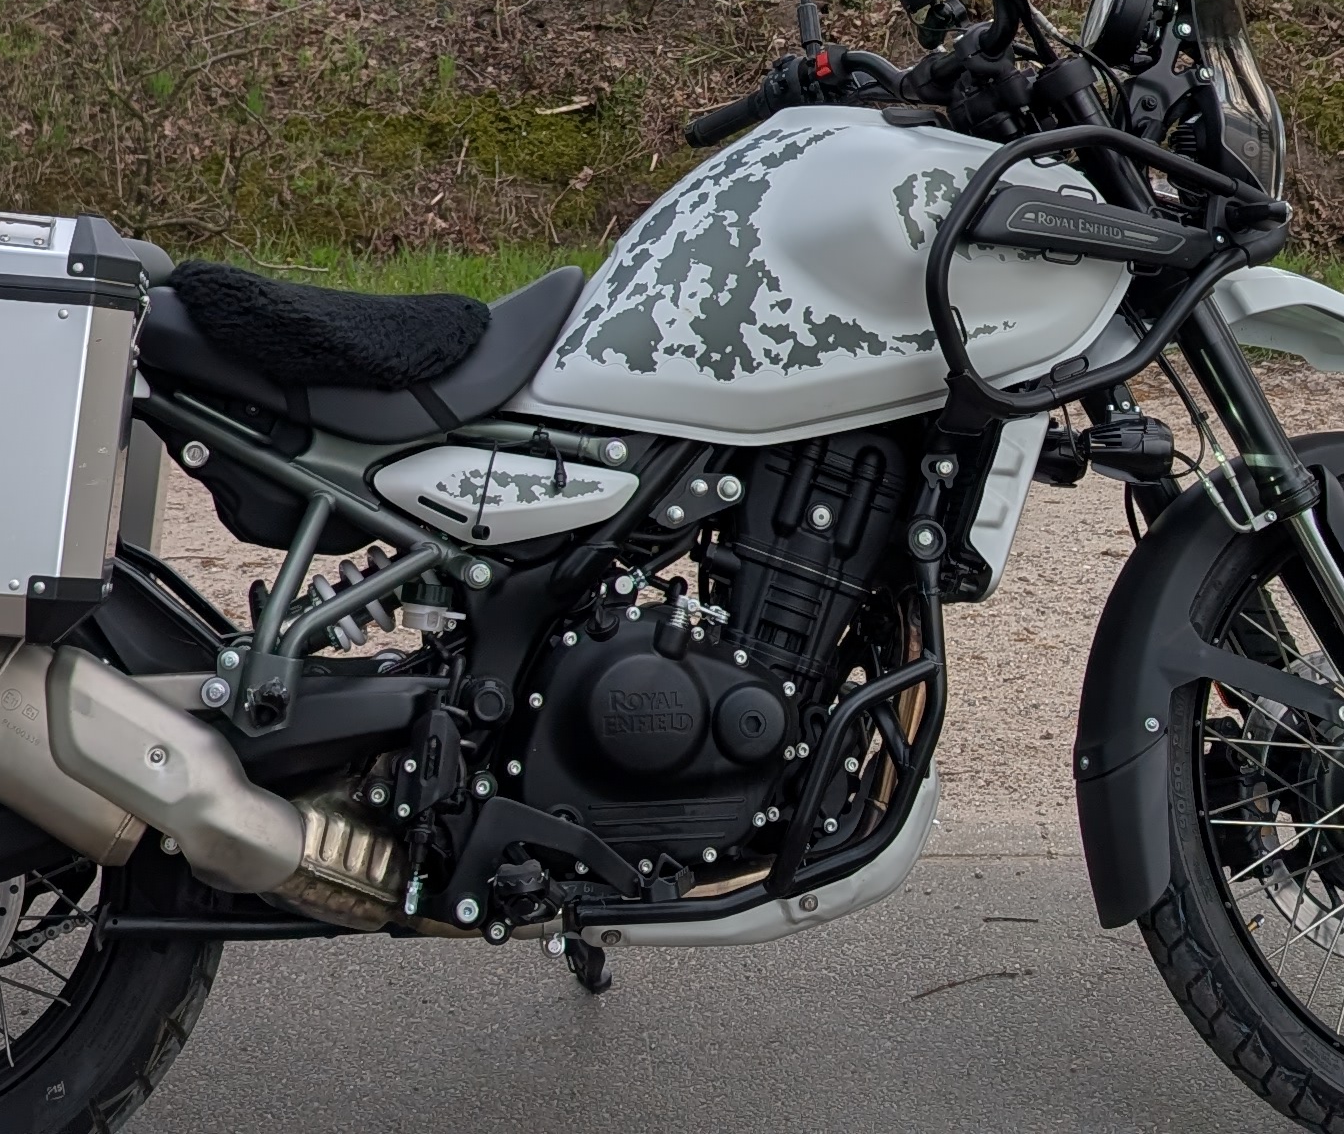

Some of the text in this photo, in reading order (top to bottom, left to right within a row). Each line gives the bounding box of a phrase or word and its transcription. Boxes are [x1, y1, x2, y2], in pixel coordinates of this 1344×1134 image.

[1037, 211, 1122, 240] ROYAL ENFIELD
[602, 689, 694, 737] ROYAL ENFIELD
